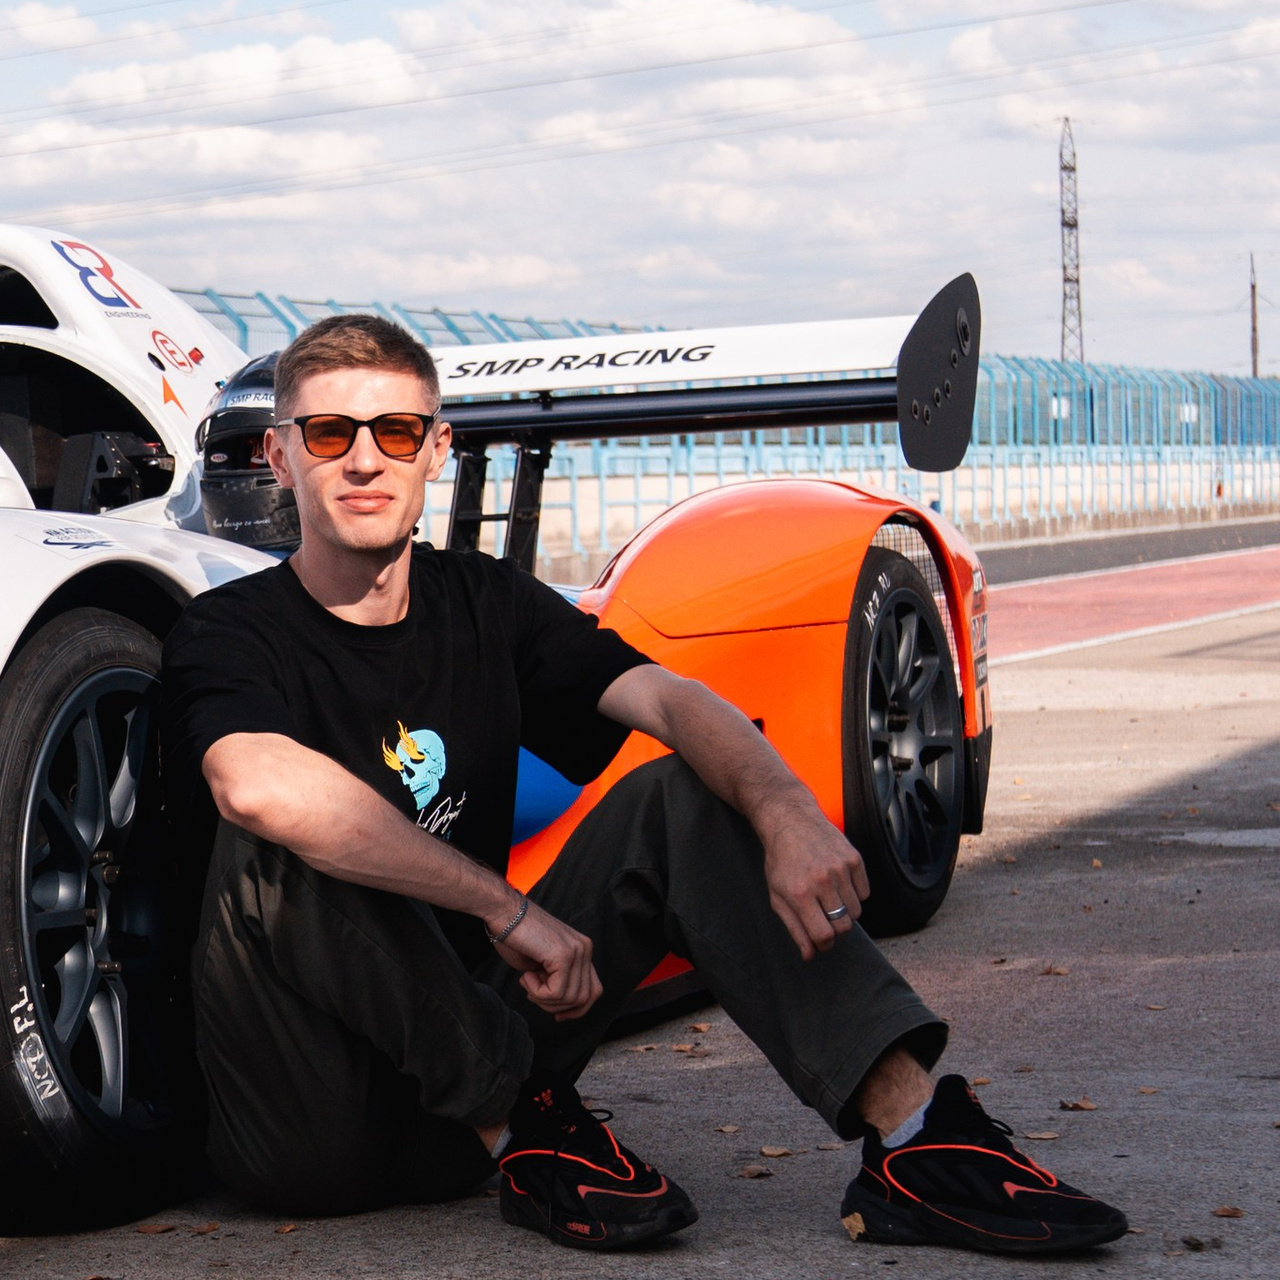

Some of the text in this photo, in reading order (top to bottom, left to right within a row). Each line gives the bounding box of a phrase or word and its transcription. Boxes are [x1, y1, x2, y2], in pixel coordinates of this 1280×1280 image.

[447, 345, 716, 379] SMP RACING
[230, 392, 275, 405] SMP RAC
